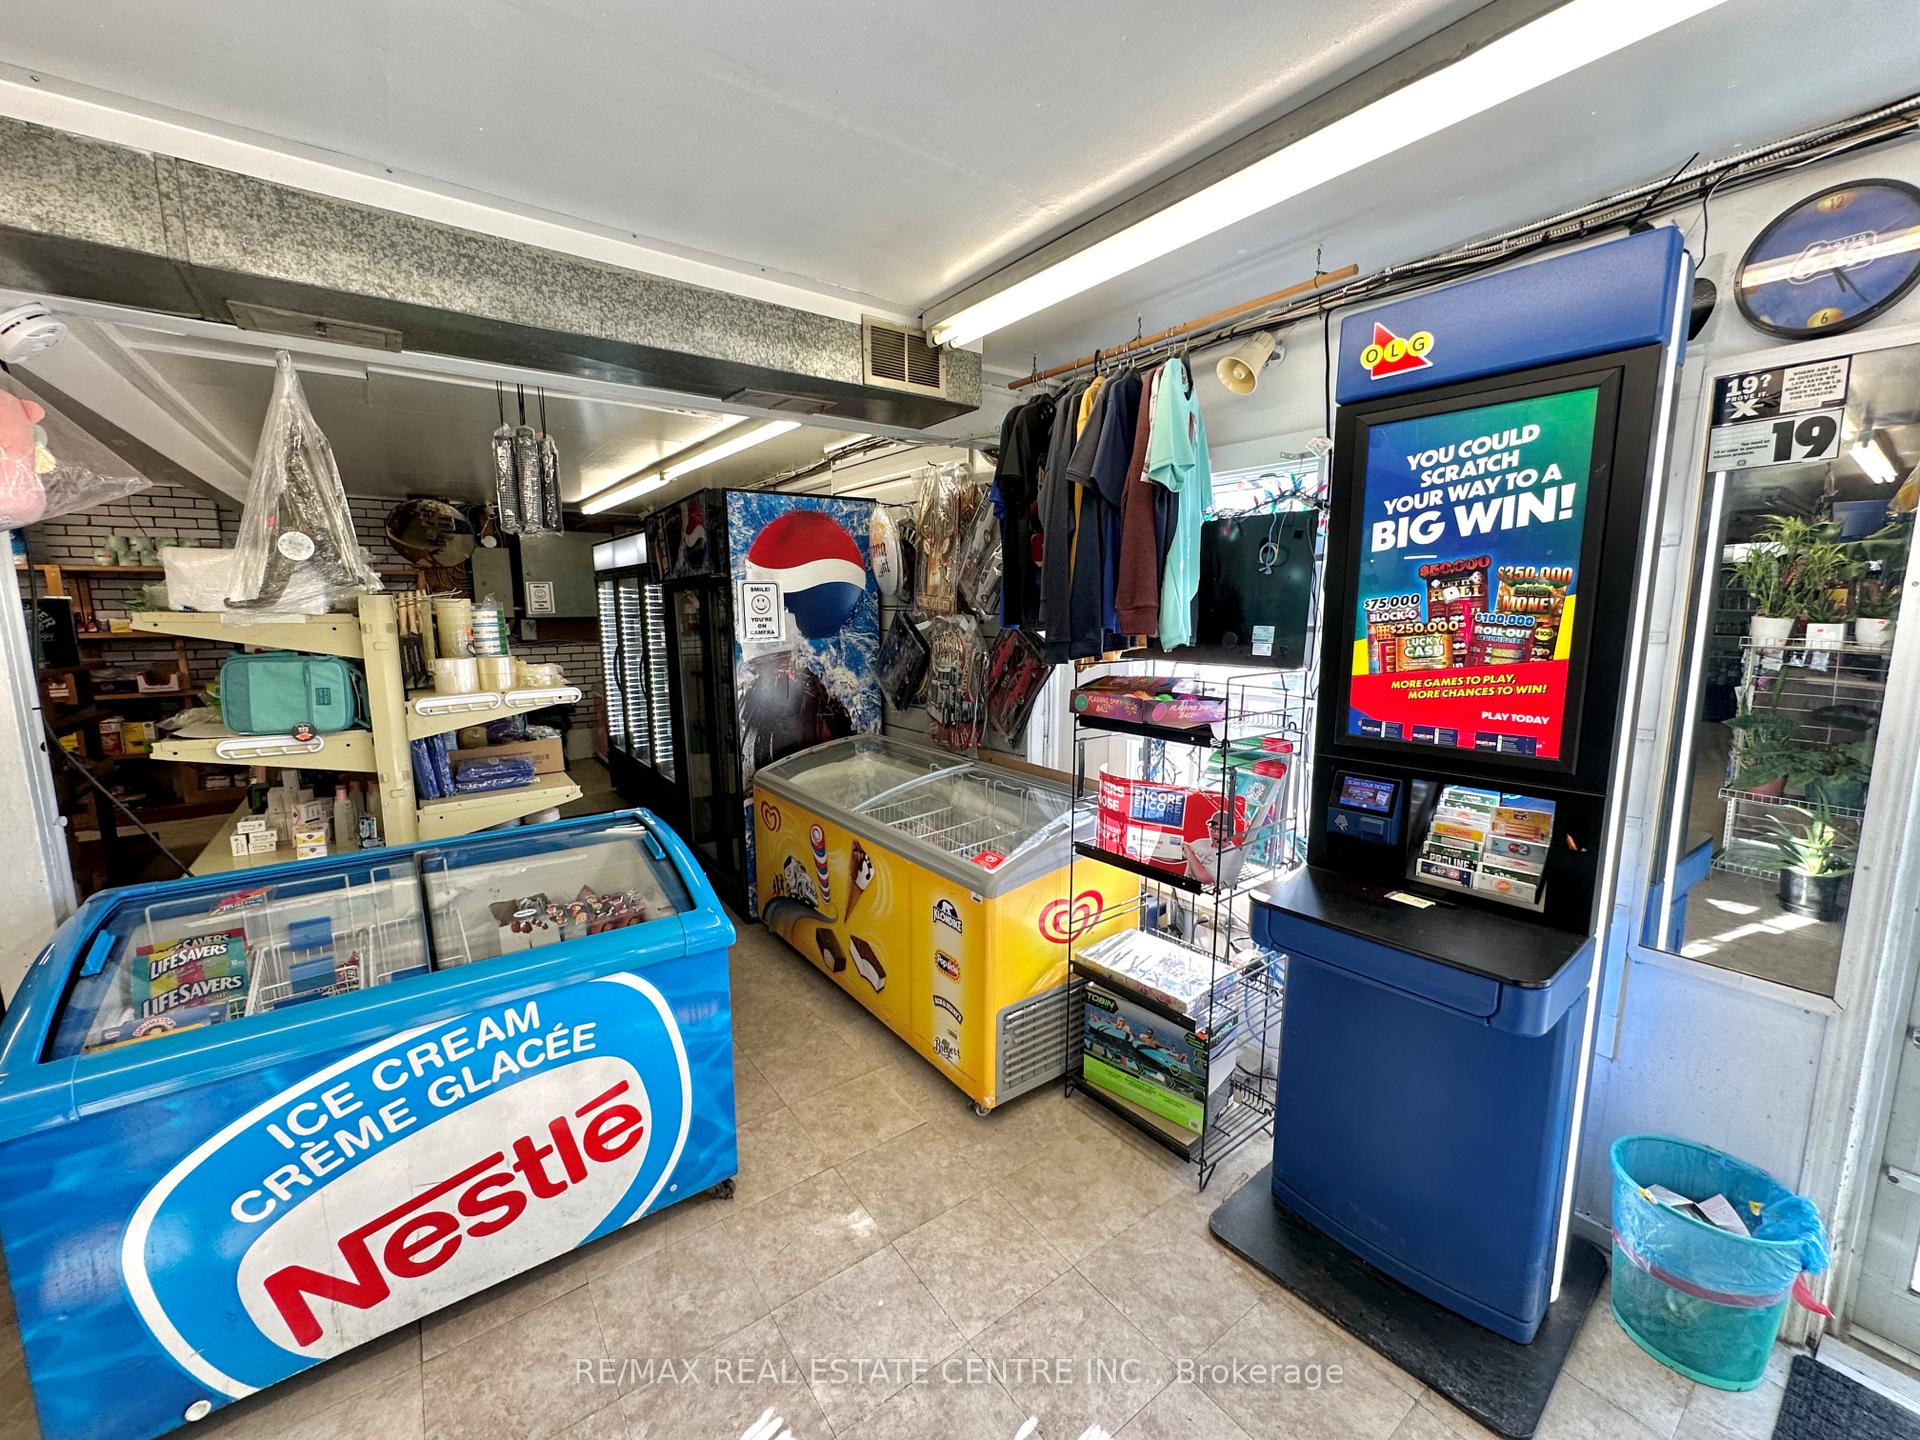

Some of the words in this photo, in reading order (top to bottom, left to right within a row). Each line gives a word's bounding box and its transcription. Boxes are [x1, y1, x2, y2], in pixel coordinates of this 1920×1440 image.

[1820, 312, 1829, 325] 6
[1364, 335, 1426, 365] OLG
[1726, 374, 1772, 398] 19?
[1725, 394, 1756, 403] PROVE
[1772, 415, 1837, 462] 19
[1407, 444, 1455, 471] YOU
[1458, 424, 1540, 458] COULD
[1420, 449, 1520, 488] SCRATCH
[1383, 489, 1444, 515] YOUR
[1447, 475, 1502, 503] WAY
[1505, 469, 1538, 490] TO
[1541, 463, 1562, 484] A
[1371, 511, 1446, 553] BIG
[1454, 483, 1577, 538] WIN!
[1419, 555, 1490, 578] $50,000
[1498, 566, 1573, 583] $350,000
[1363, 594, 1421, 610] $75,000
[1502, 595, 1560, 613] MONEY
[1390, 621, 1461, 635] $250,000
[1475, 612, 1535, 627] $100,000
[1406, 635, 1443, 648] LUCKY
[1404, 645, 1444, 658] CASH
[1391, 678, 1422, 689] MORE
[1424, 677, 1464, 688] GAMES
[1465, 676, 1481, 686] TO
[1482, 674, 1517, 685] PLAY,
[1408, 689, 1440, 700] MORE
[1441, 687, 1495, 698] CHANCES
[1497, 686, 1514, 696] TO
[1516, 684, 1548, 695] WIN!
[1481, 711, 1509, 722] PLAY
[1510, 713, 1550, 725] TODAY
[1134, 788, 1183, 805] ENCORE
[1134, 797, 1182, 814] ENCORE
[1087, 992, 1115, 1009] TOBIN
[266, 1080, 364, 1150] ICE
[372, 1001, 542, 1093] CREAM
[231, 1107, 417, 1223] CRÈME
[427, 1021, 597, 1109] GLACÉE
[263, 1080, 645, 1348] Nestlé
